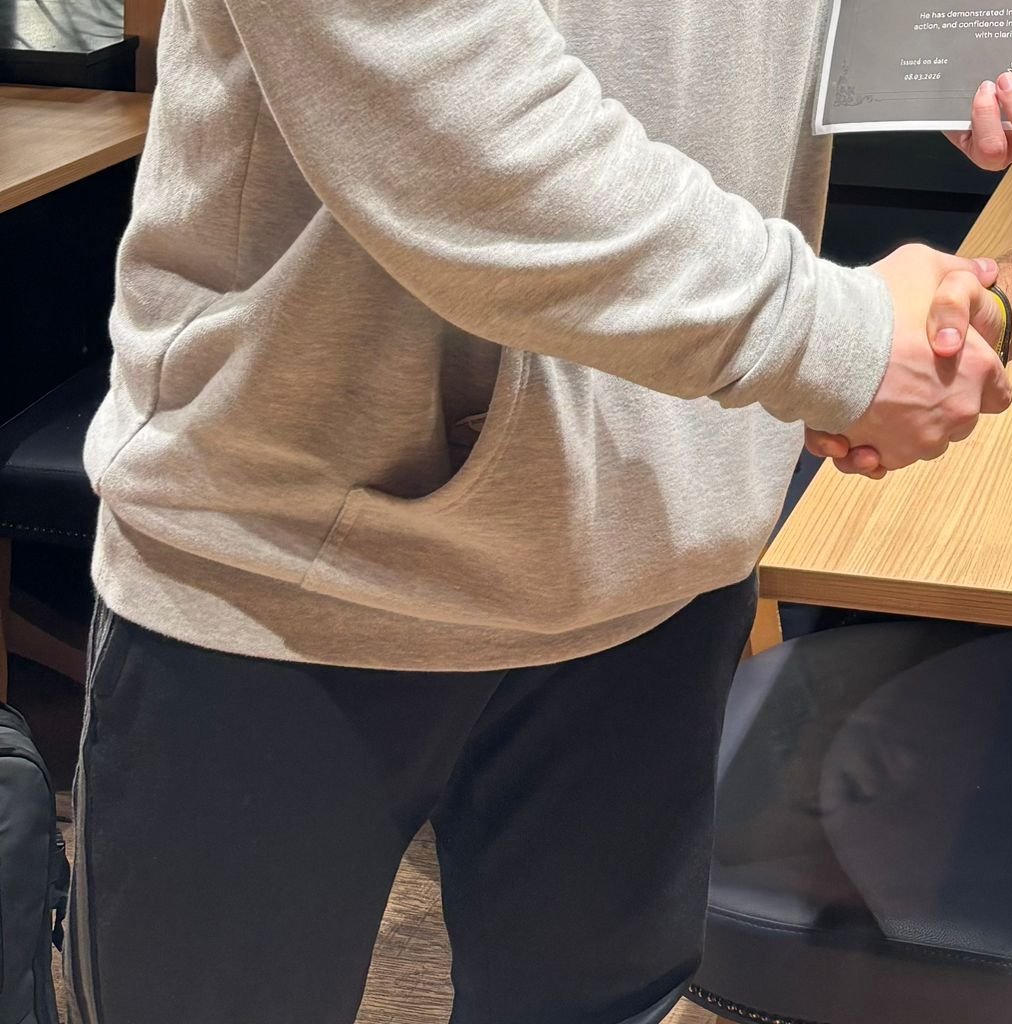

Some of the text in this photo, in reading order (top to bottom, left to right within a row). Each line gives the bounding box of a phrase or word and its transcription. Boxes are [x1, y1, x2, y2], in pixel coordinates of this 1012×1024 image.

[947, 9, 1004, 18] demonstrated
[914, 22, 940, 30] action,
[942, 21, 957, 29] and
[959, 20, 1005, 28] confidence
